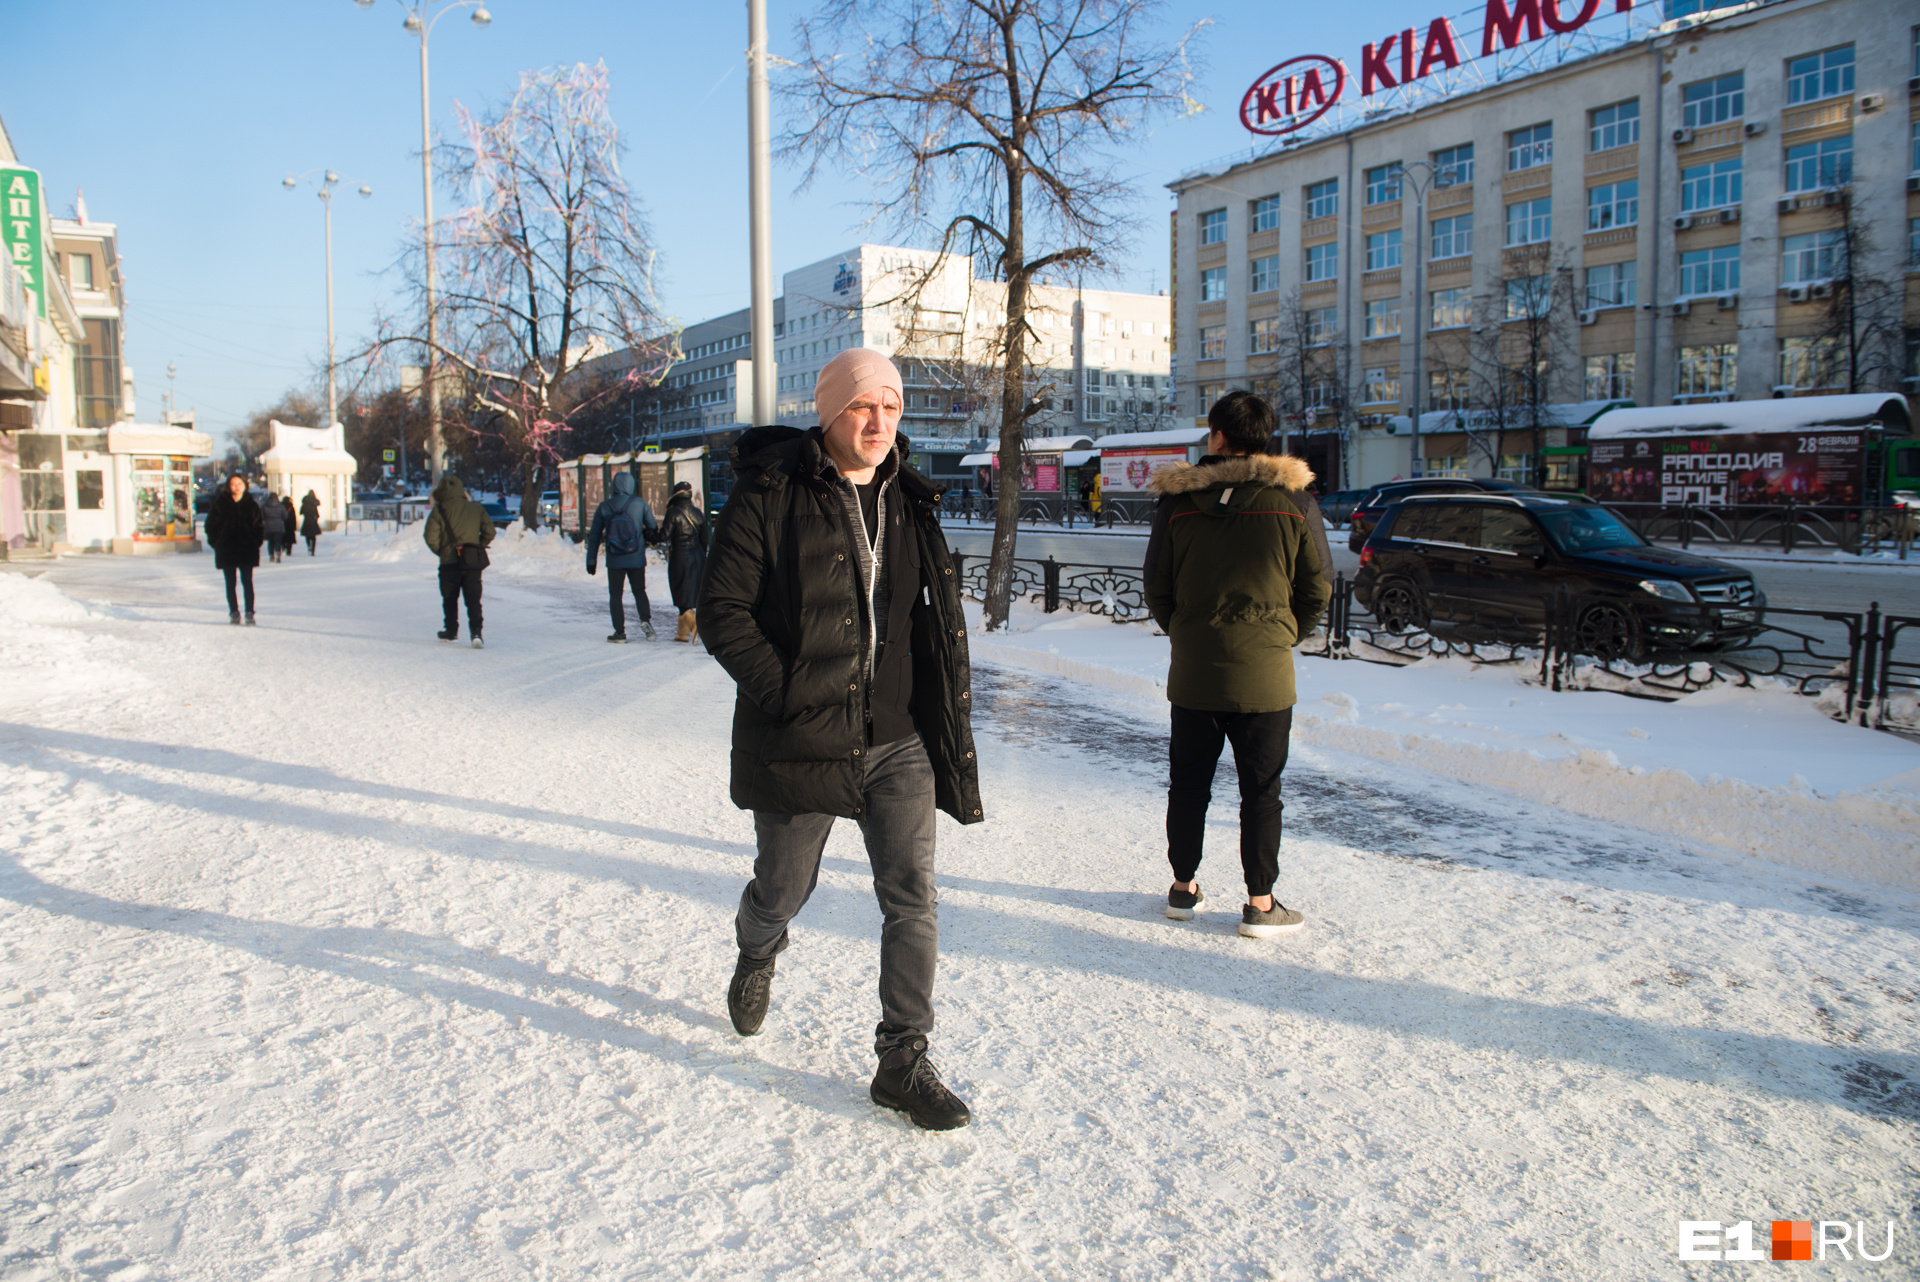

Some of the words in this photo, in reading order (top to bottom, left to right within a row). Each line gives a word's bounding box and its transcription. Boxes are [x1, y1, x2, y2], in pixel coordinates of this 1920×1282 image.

[1361, 15, 1460, 97] KIA
[1256, 67, 1328, 124] KIA
[8, 176, 35, 284] АПТЕК
[1662, 452, 1783, 471] РАПСОДИЯ
[1797, 437, 1817, 453] 28
[1818, 435, 1860, 446] ФЕВРАЛЯ
[1662, 472, 1673, 484] В
[1675, 472, 1729, 484] СТИЛЕ
